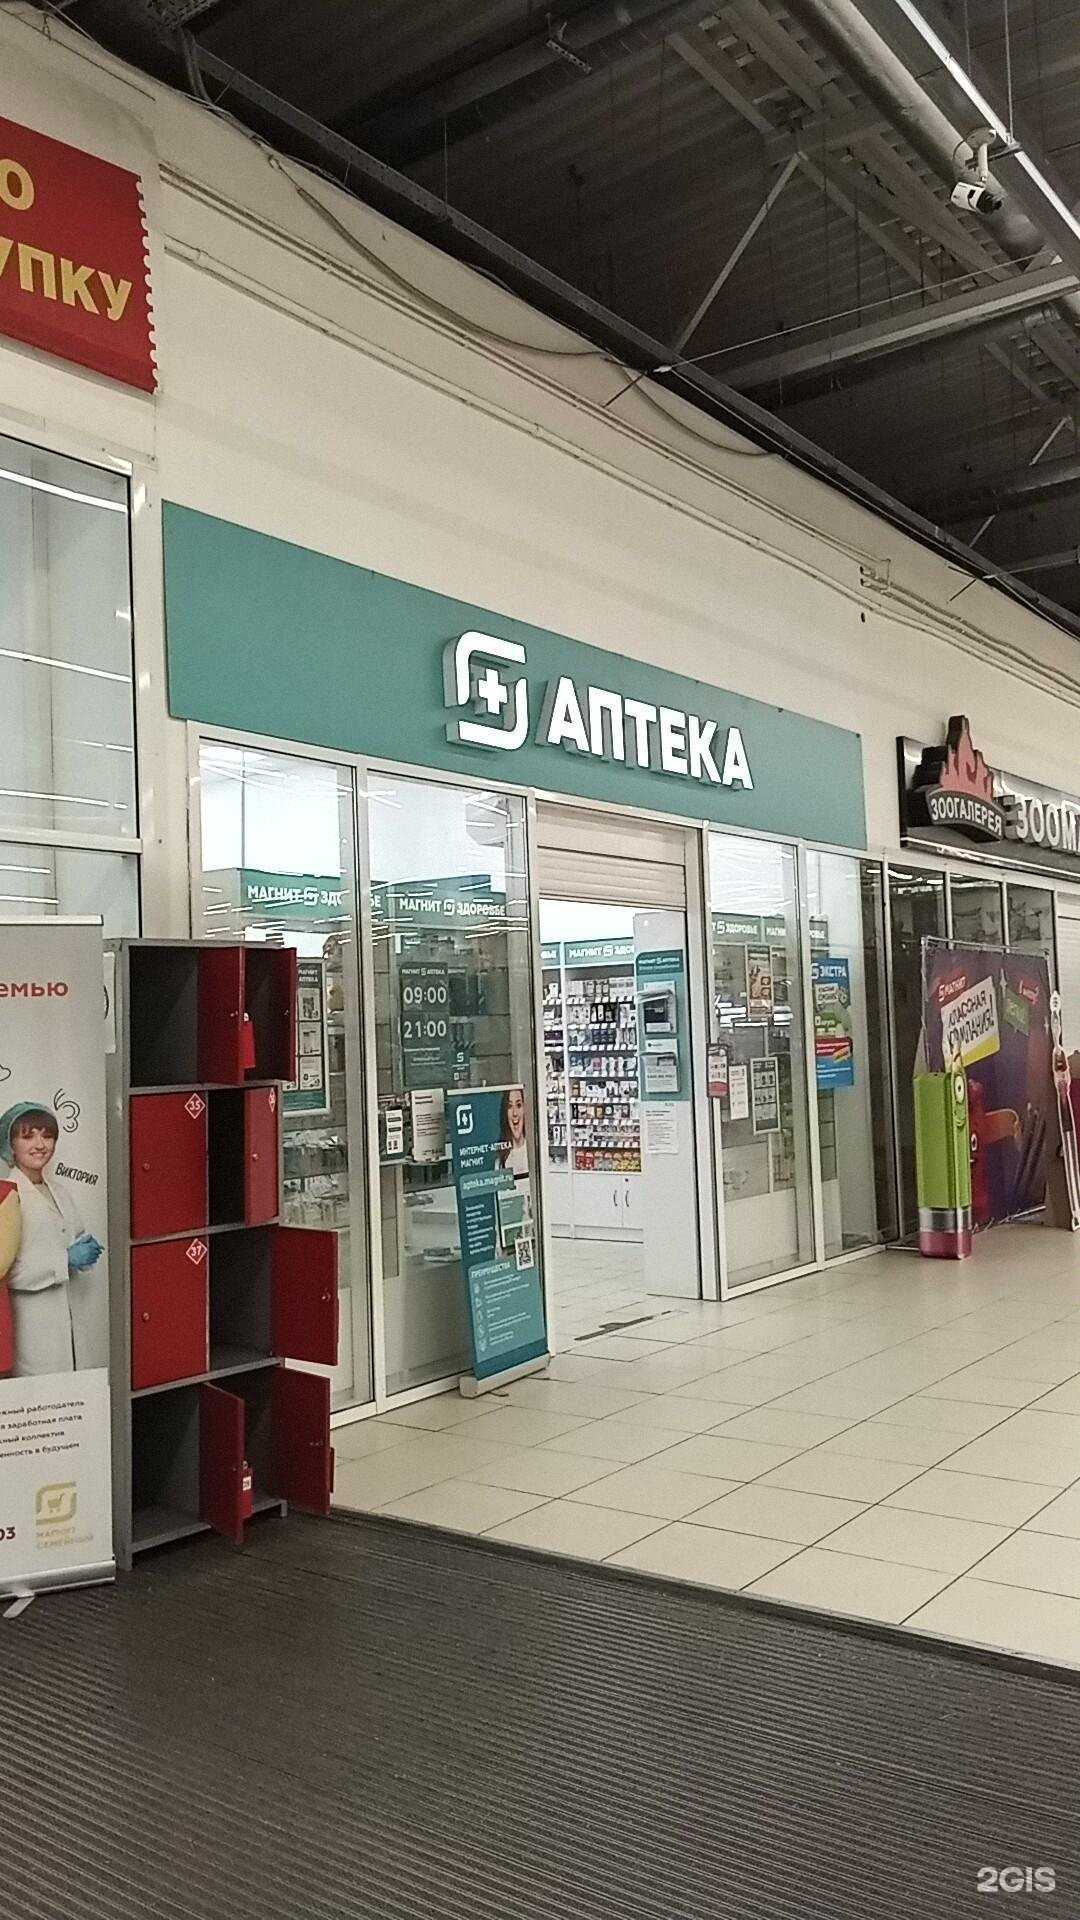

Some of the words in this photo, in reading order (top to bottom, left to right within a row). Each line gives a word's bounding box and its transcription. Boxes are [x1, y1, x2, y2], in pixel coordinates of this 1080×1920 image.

[548, 676, 753, 789] АПТЕКА
[930, 797, 1002, 836] ЗООГАЛЕРЕЯ
[1015, 797, 1080, 853] ЗООМ
[248, 885, 301, 901] МАГНИТ
[400, 897, 441, 912] МАГНИТ
[455, 902, 505, 916] ЗДОРОВЬЕ
[820, 965, 847, 977] ЭКСТРА
[403, 986, 447, 1004] 09:00
[403, 1020, 447, 1038] 21:00
[190, 1100, 200, 1111] 35
[190, 1245, 202, 1257] 37
[26, 1401, 85, 1414] работодатель
[8, 1419, 57, 1430] заработная
[58, 1414, 83, 1423] плата
[21, 1430, 65, 1441] коллектив
[42, 1442, 80, 1454] будущем
